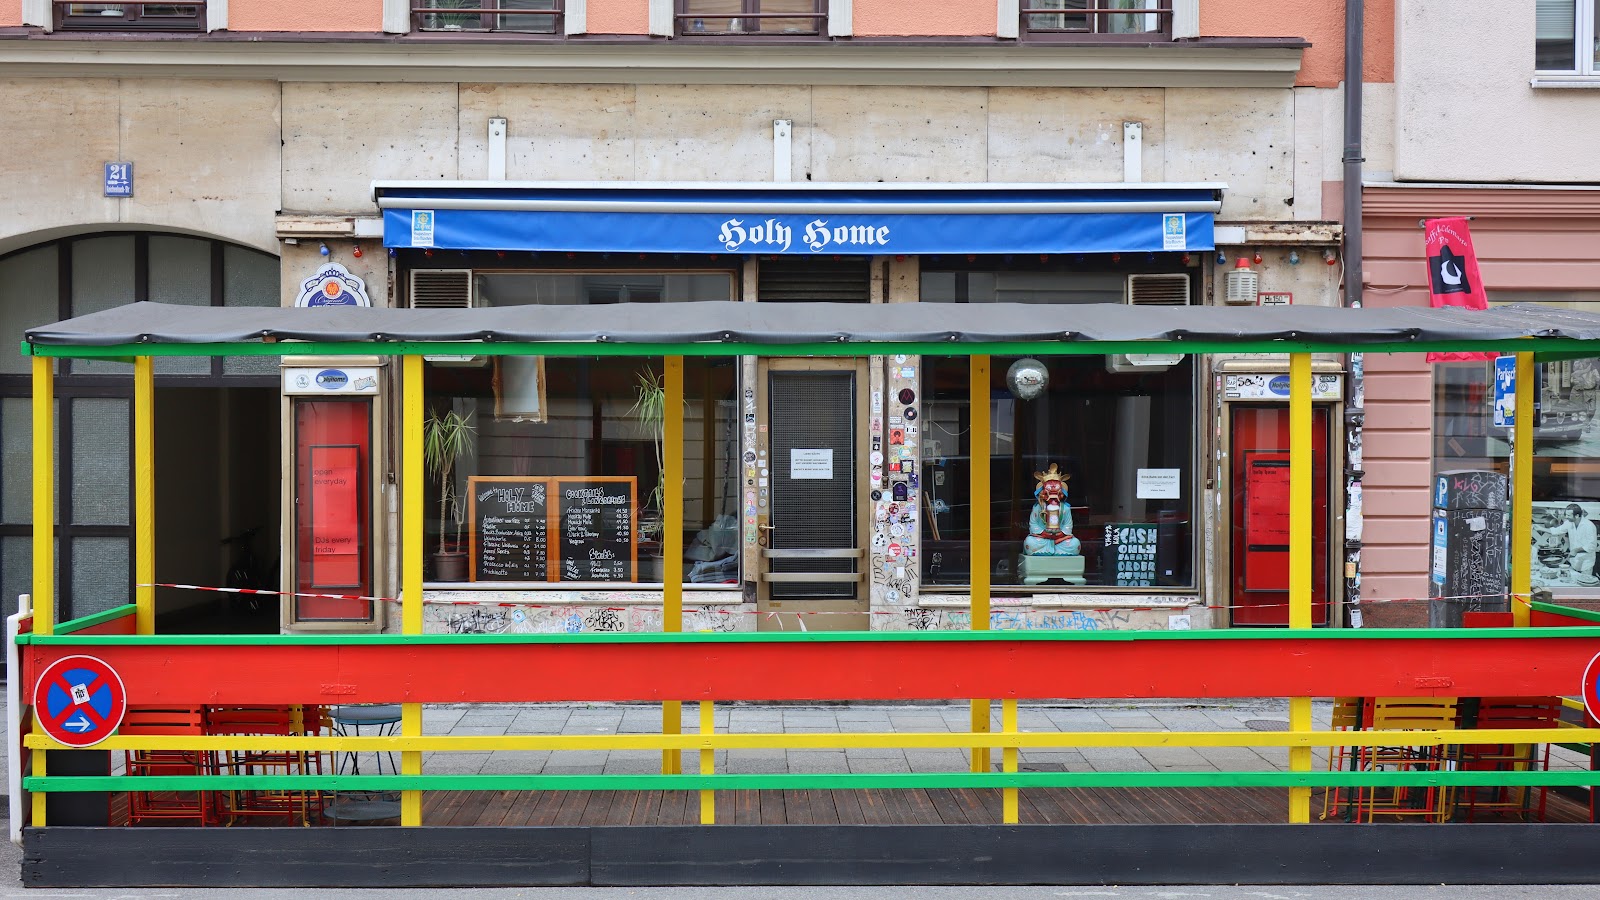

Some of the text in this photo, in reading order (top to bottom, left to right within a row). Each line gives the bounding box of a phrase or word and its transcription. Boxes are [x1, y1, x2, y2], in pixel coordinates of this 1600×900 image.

[110, 164, 127, 180] 21
[718, 218, 891, 252] Holy Home
[497, 487, 525, 503] HOLY
[506, 501, 535, 513] HOME
[331, 537, 352, 545] every
[1120, 527, 1158, 545] CASH
[315, 546, 336, 554] friday
[1117, 544, 1157, 554] ONLY
[1117, 553, 1155, 561] PLEASE
[1117, 560, 1156, 572] ORDER
[1117, 571, 1155, 580] AT THE
